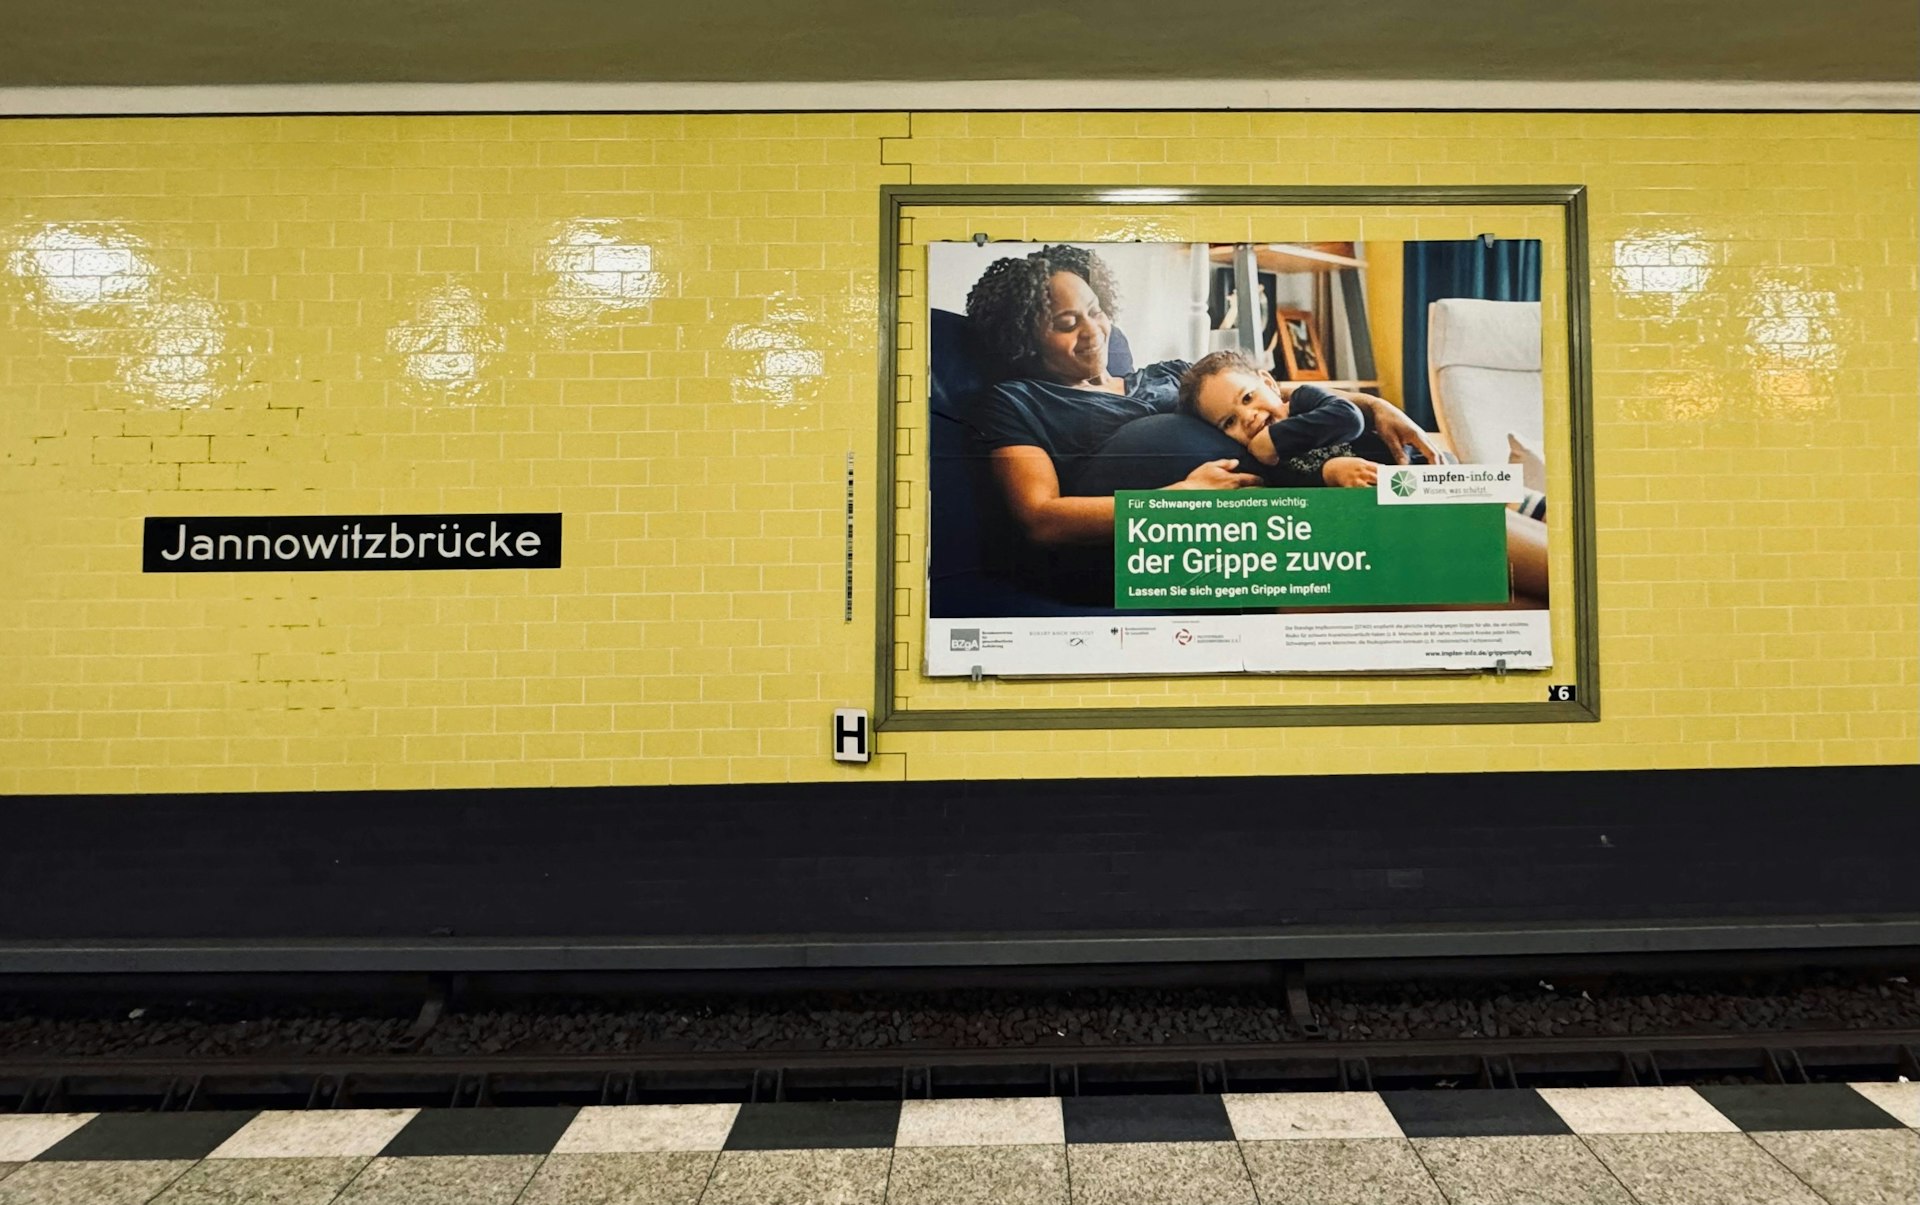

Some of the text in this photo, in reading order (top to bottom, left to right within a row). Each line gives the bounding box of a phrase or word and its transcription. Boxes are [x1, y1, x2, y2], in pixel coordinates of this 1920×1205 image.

[1422, 470, 1512, 485] impfen-info.de
[1449, 486, 1462, 495] was
[1128, 499, 1145, 509] Für
[1148, 498, 1213, 511] Schwangere
[1216, 497, 1269, 509] besonders
[1128, 515, 1313, 543] Kommen Sie
[160, 521, 542, 561] Jannowitzbrücke
[1127, 547, 1372, 579] der Grippe zuvor.
[1128, 583, 1332, 598] Lassen Sie sich gegen Grippe impfen!
[951, 639, 979, 651] BZgA
[1558, 686, 1570, 701] 6
[836, 715, 866, 755] H
